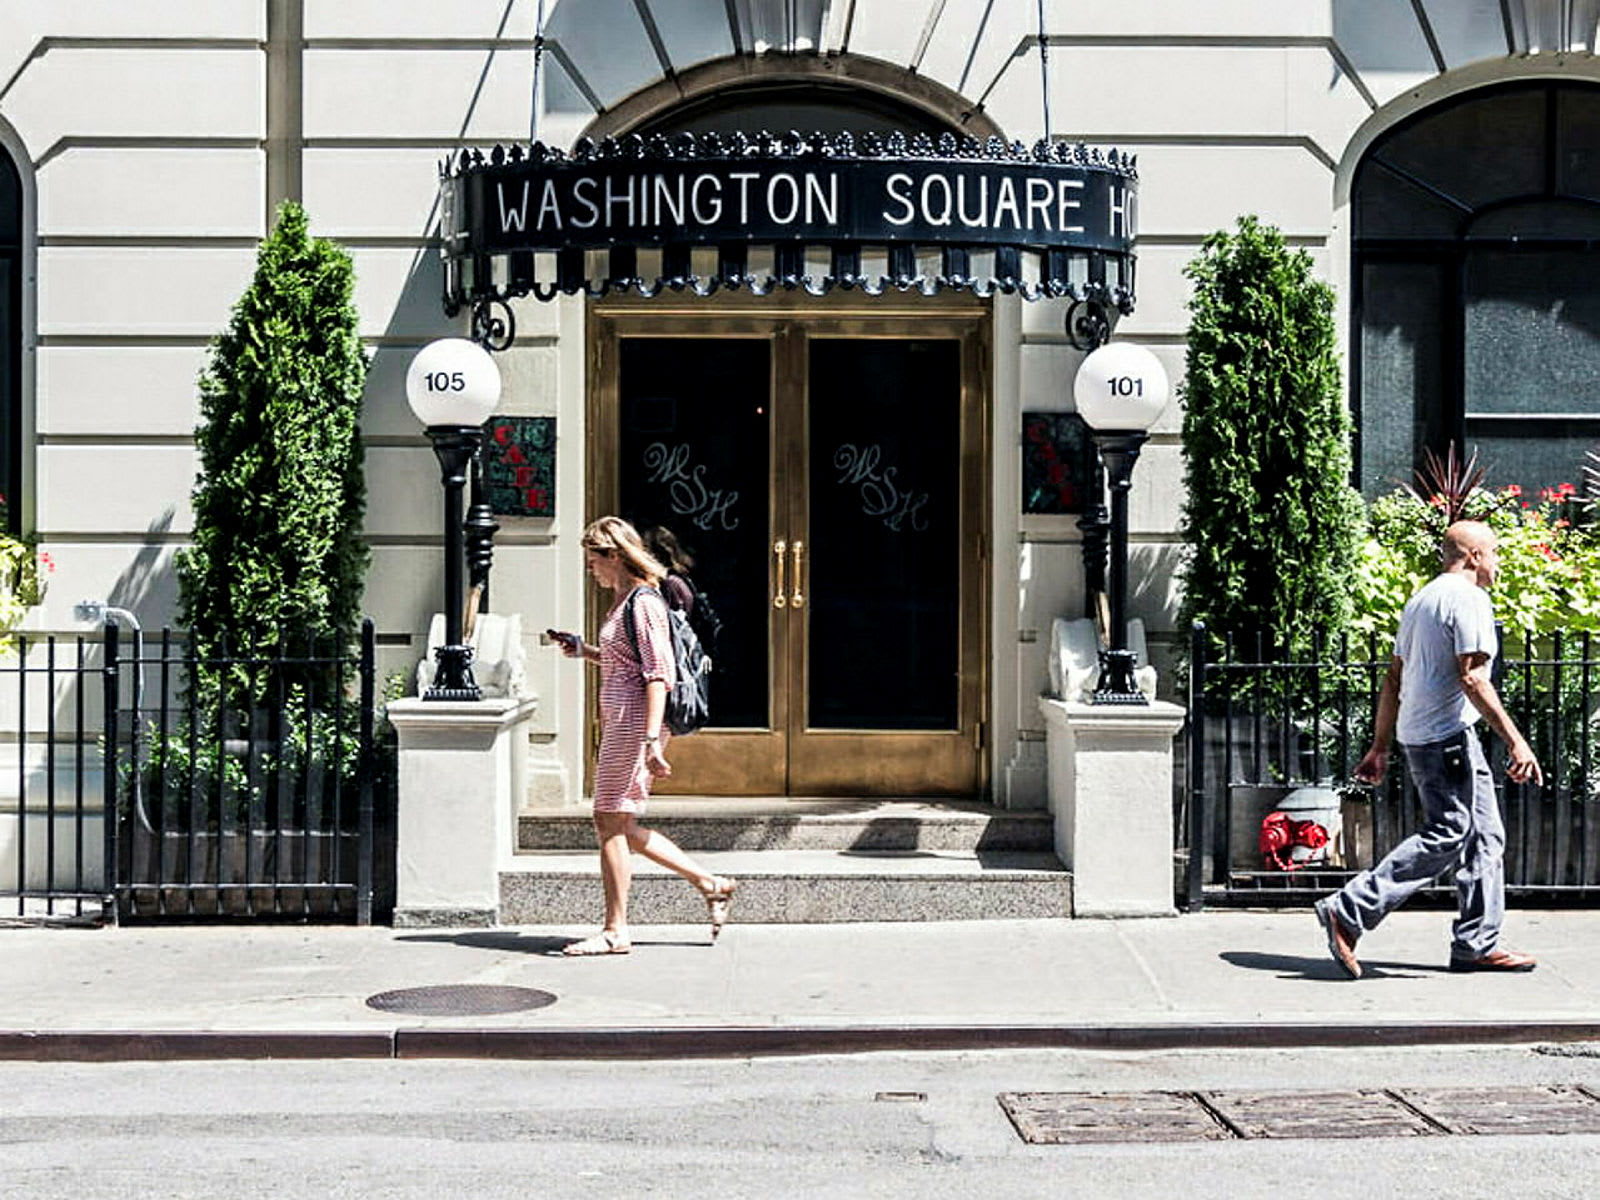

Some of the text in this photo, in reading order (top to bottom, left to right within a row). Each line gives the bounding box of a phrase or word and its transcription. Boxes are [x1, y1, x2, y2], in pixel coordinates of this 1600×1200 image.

[497, 173, 837, 232] WASHINGTON
[883, 173, 1085, 233] SQUARE
[424, 372, 465, 392] 105
[1107, 376, 1143, 397] 101
